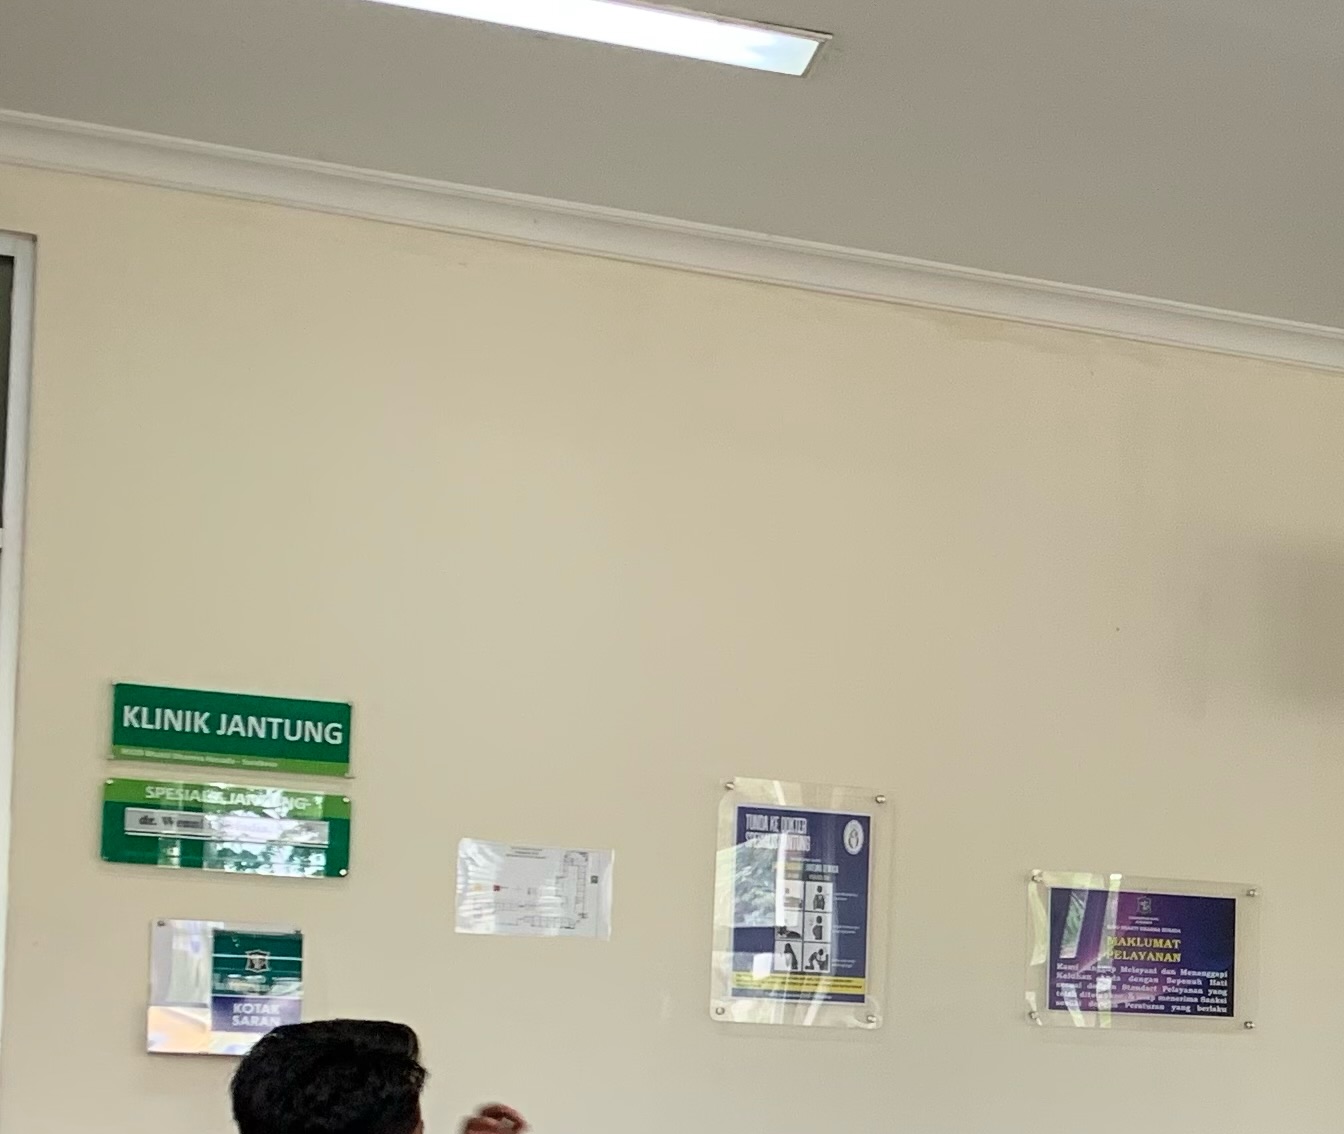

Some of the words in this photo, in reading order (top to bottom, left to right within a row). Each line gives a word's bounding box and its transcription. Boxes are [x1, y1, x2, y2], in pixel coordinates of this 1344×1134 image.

[123, 704, 211, 734] KLINIK
[216, 713, 344, 745] JANTUNG
[1106, 935, 1182, 950] MAKLUMAT
[1106, 950, 1182, 963] PELAYANAN
[1128, 975, 1159, 984] dengan
[1209, 979, 1228, 987] Hati
[1162, 985, 1204, 995] Pelayanan
[1207, 989, 1229, 997] yang
[232, 1002, 280, 1015] KOTAK
[1170, 1004, 1192, 1013] yang
[1196, 1004, 1228, 1013] berlaku
[232, 1015, 281, 1027] SARAN
